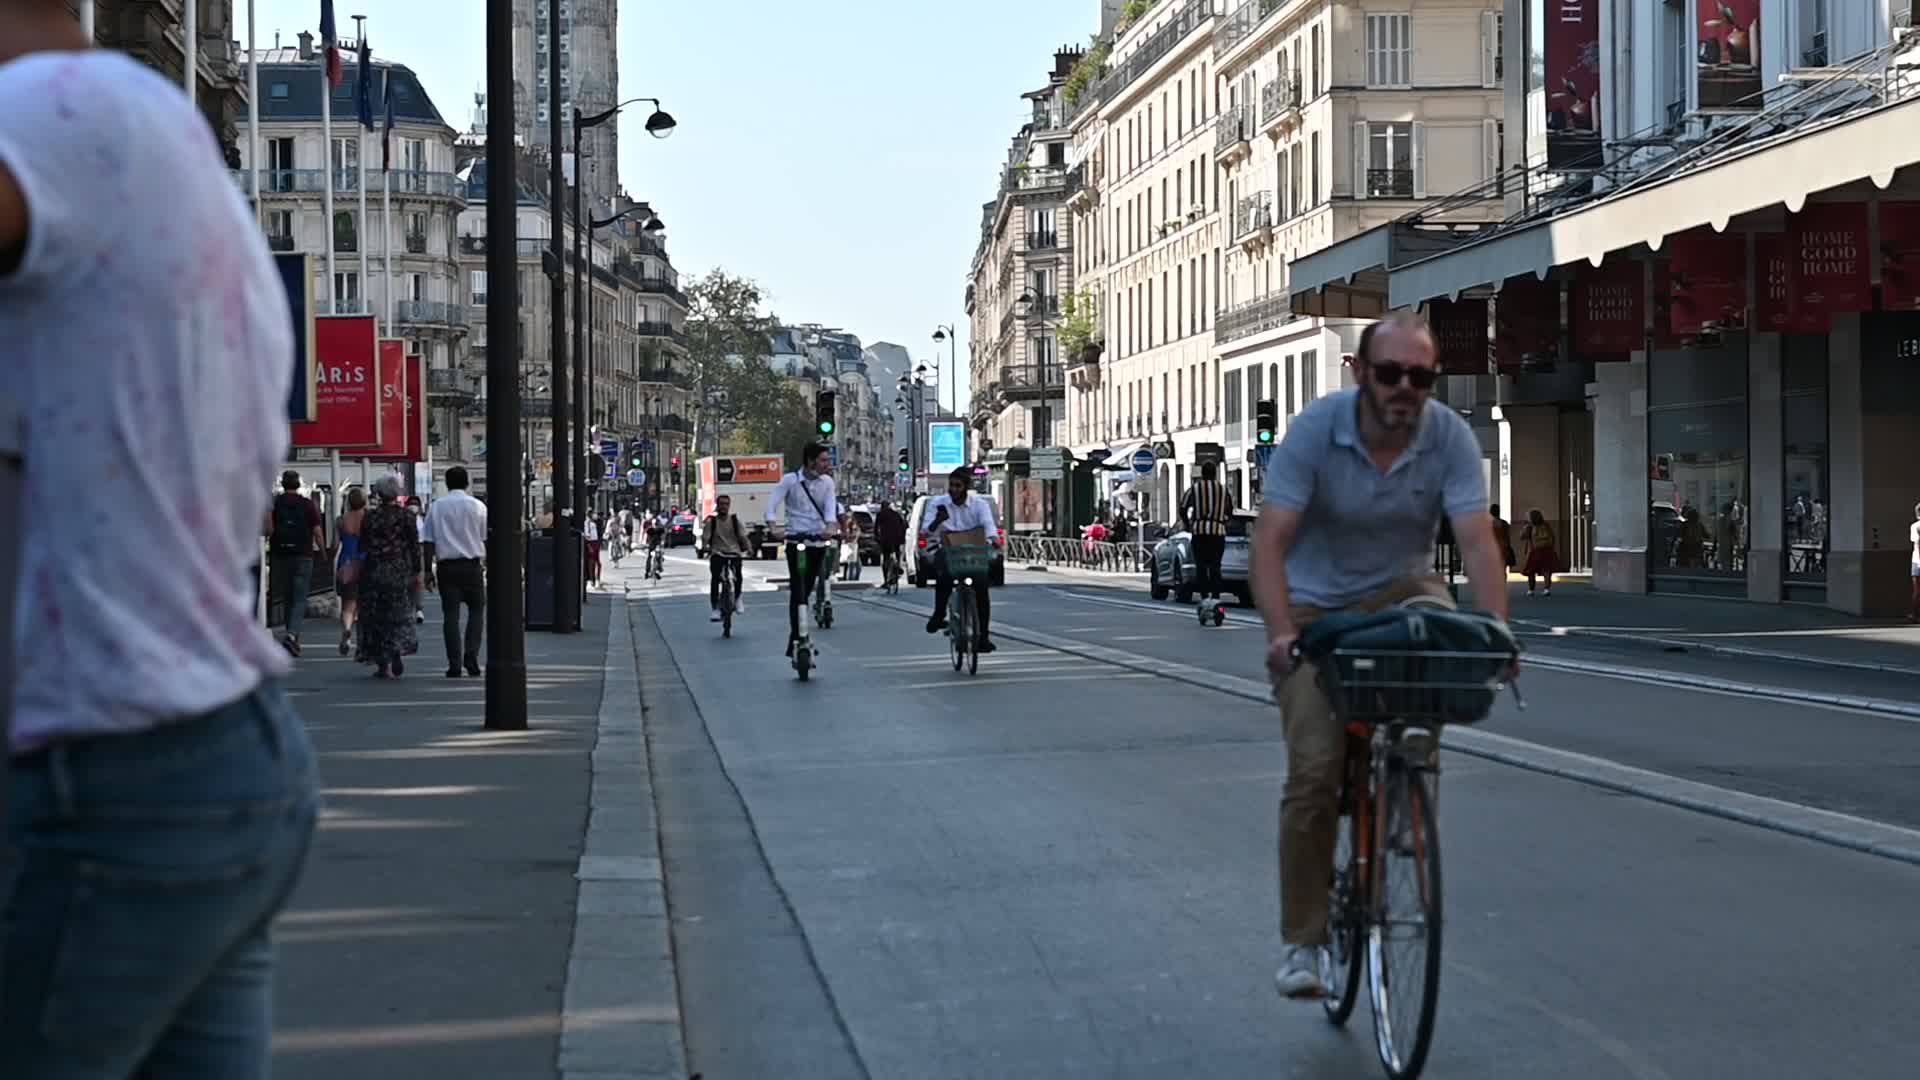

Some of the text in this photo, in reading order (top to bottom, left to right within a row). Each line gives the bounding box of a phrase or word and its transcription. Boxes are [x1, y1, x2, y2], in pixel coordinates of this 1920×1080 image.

[1801, 231, 1856, 247] HOME
[1801, 246, 1857, 260] GOOD
[1802, 260, 1857, 276] HOME
[1587, 309, 1632, 321] HOME
